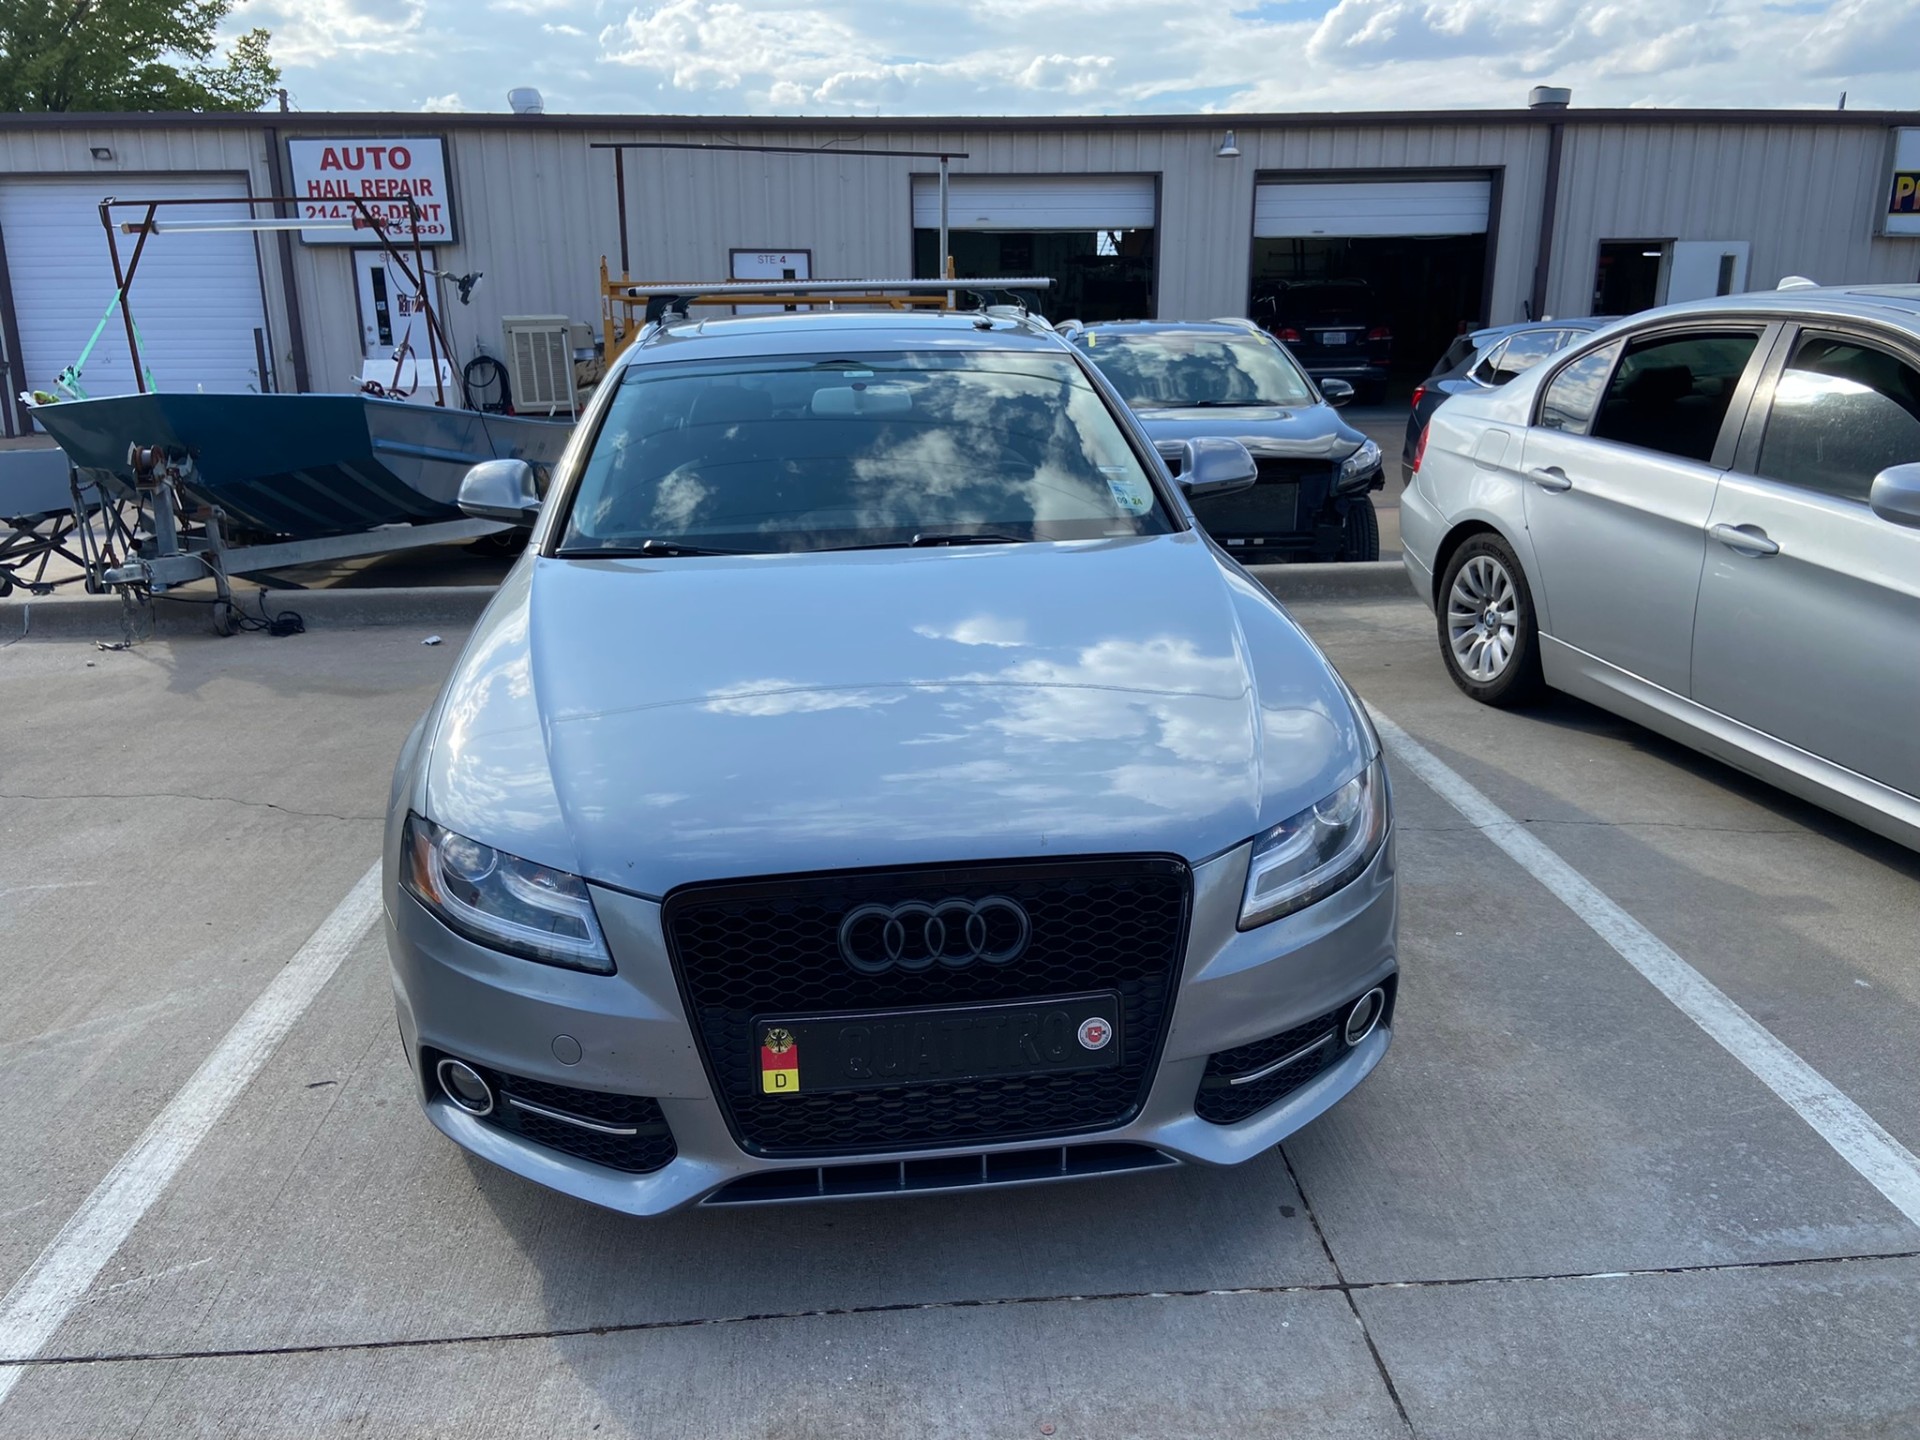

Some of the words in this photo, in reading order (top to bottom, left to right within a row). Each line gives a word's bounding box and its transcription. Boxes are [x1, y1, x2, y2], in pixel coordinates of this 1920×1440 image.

[320, 146, 412, 171] AUTO
[307, 179, 355, 199] HAIL
[361, 178, 434, 199] REPAIR
[402, 253, 410, 263] 5
[757, 255, 776, 264] STE
[780, 255, 787, 264] 4
[839, 1010, 1074, 1080] QUATTRO
[775, 1073, 787, 1088] D
